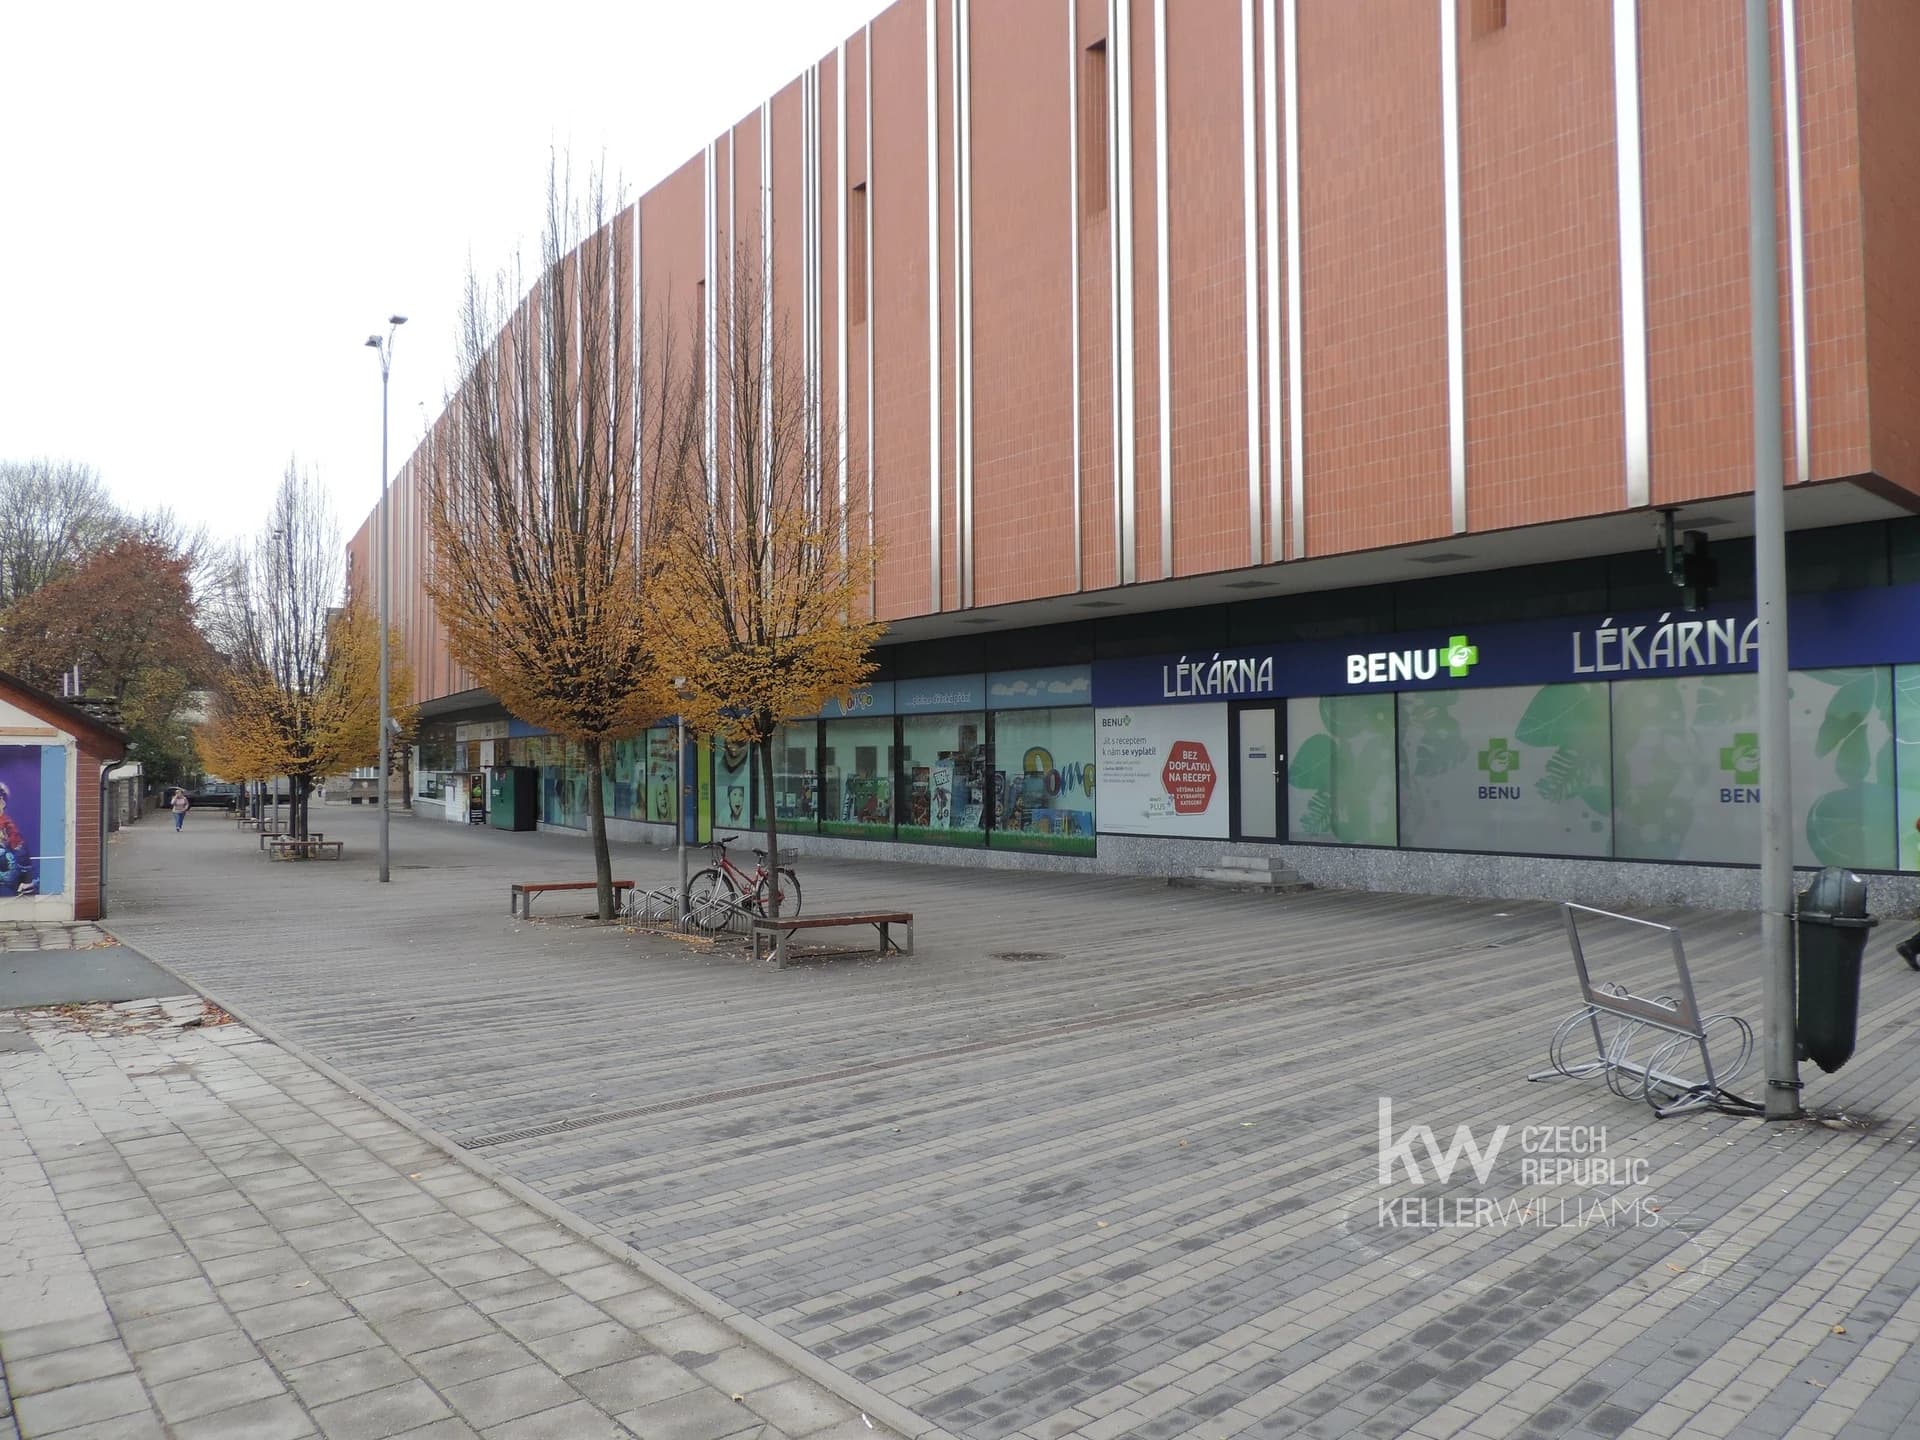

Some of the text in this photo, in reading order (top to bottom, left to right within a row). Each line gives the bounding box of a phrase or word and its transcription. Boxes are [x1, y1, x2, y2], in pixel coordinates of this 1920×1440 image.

[1573, 612, 1759, 674] LÉKÁRNA
[1346, 648, 1437, 684] BENU
[1163, 652, 1273, 698] LÉKÁRNA
[1102, 718, 1123, 728] BENU
[1116, 737, 1147, 746] receptem
[1182, 750, 1198, 760] BEZ
[1169, 761, 1211, 772] DOPLATKU
[1168, 773, 1211, 782] NA RECEPT
[1478, 786, 1521, 800] BENU
